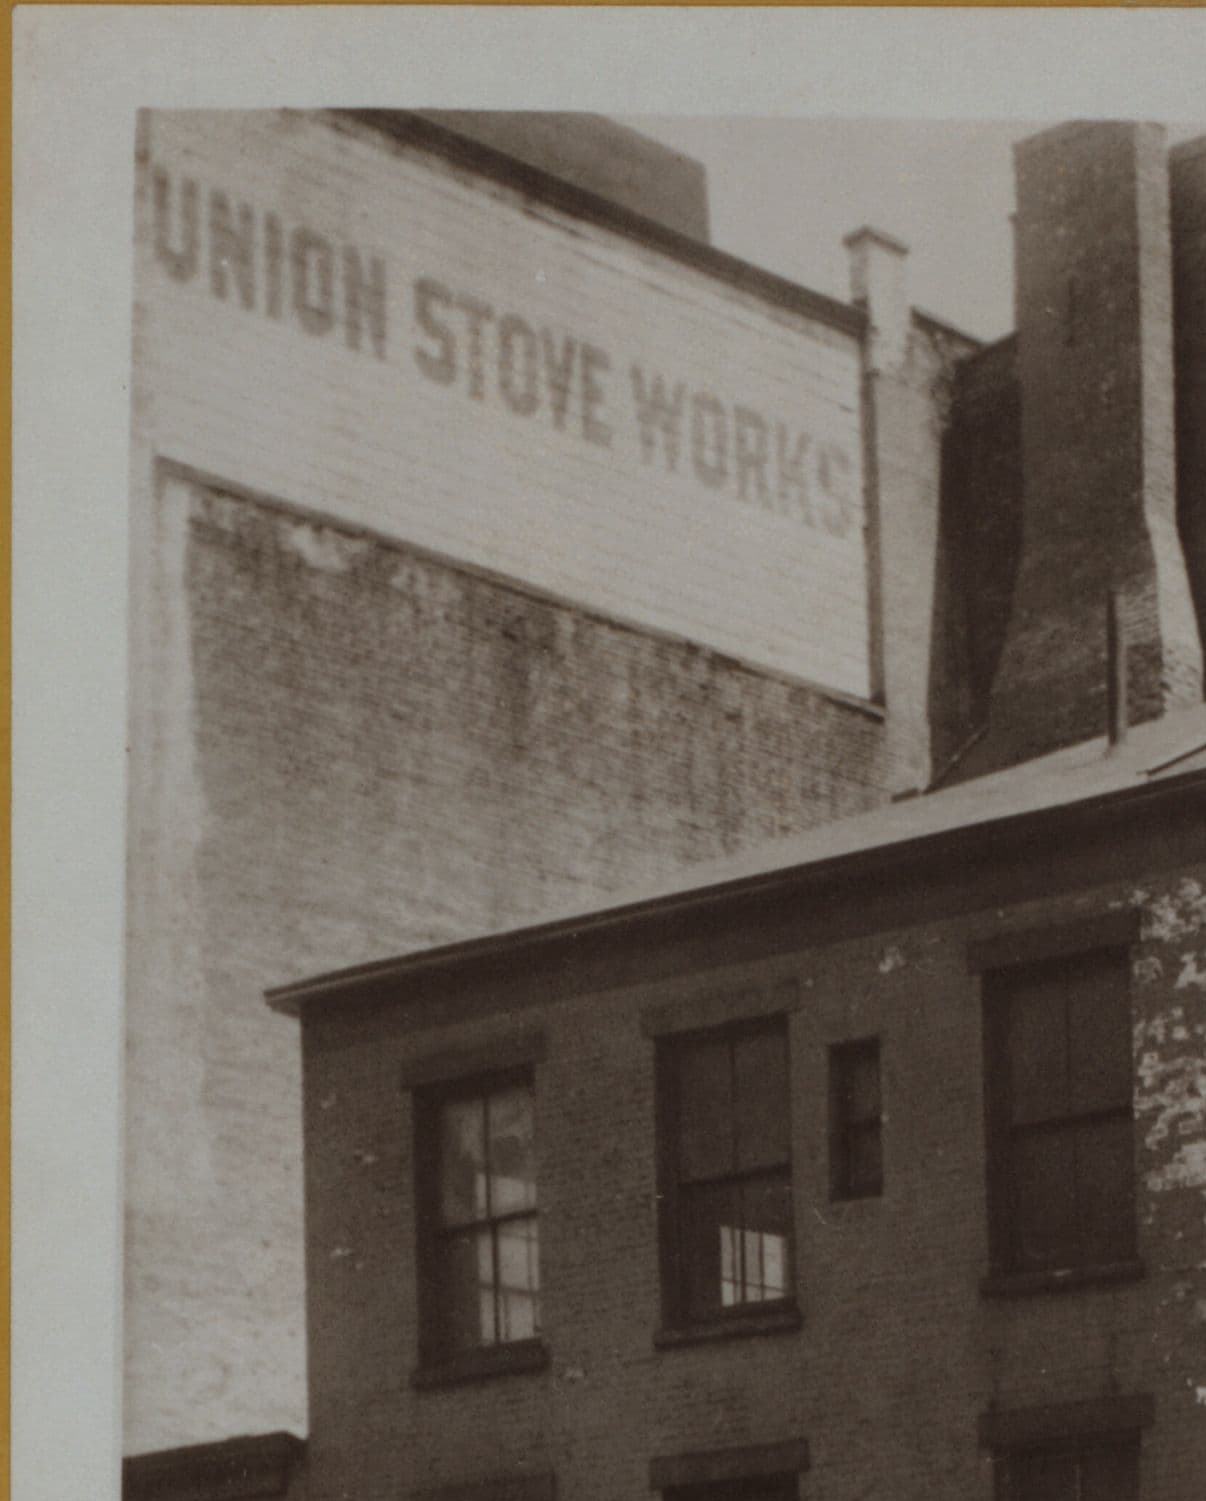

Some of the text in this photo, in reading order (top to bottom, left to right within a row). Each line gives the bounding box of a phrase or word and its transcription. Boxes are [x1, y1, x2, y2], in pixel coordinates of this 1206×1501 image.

[153, 166, 852, 538] UNION STOVE WORKS
